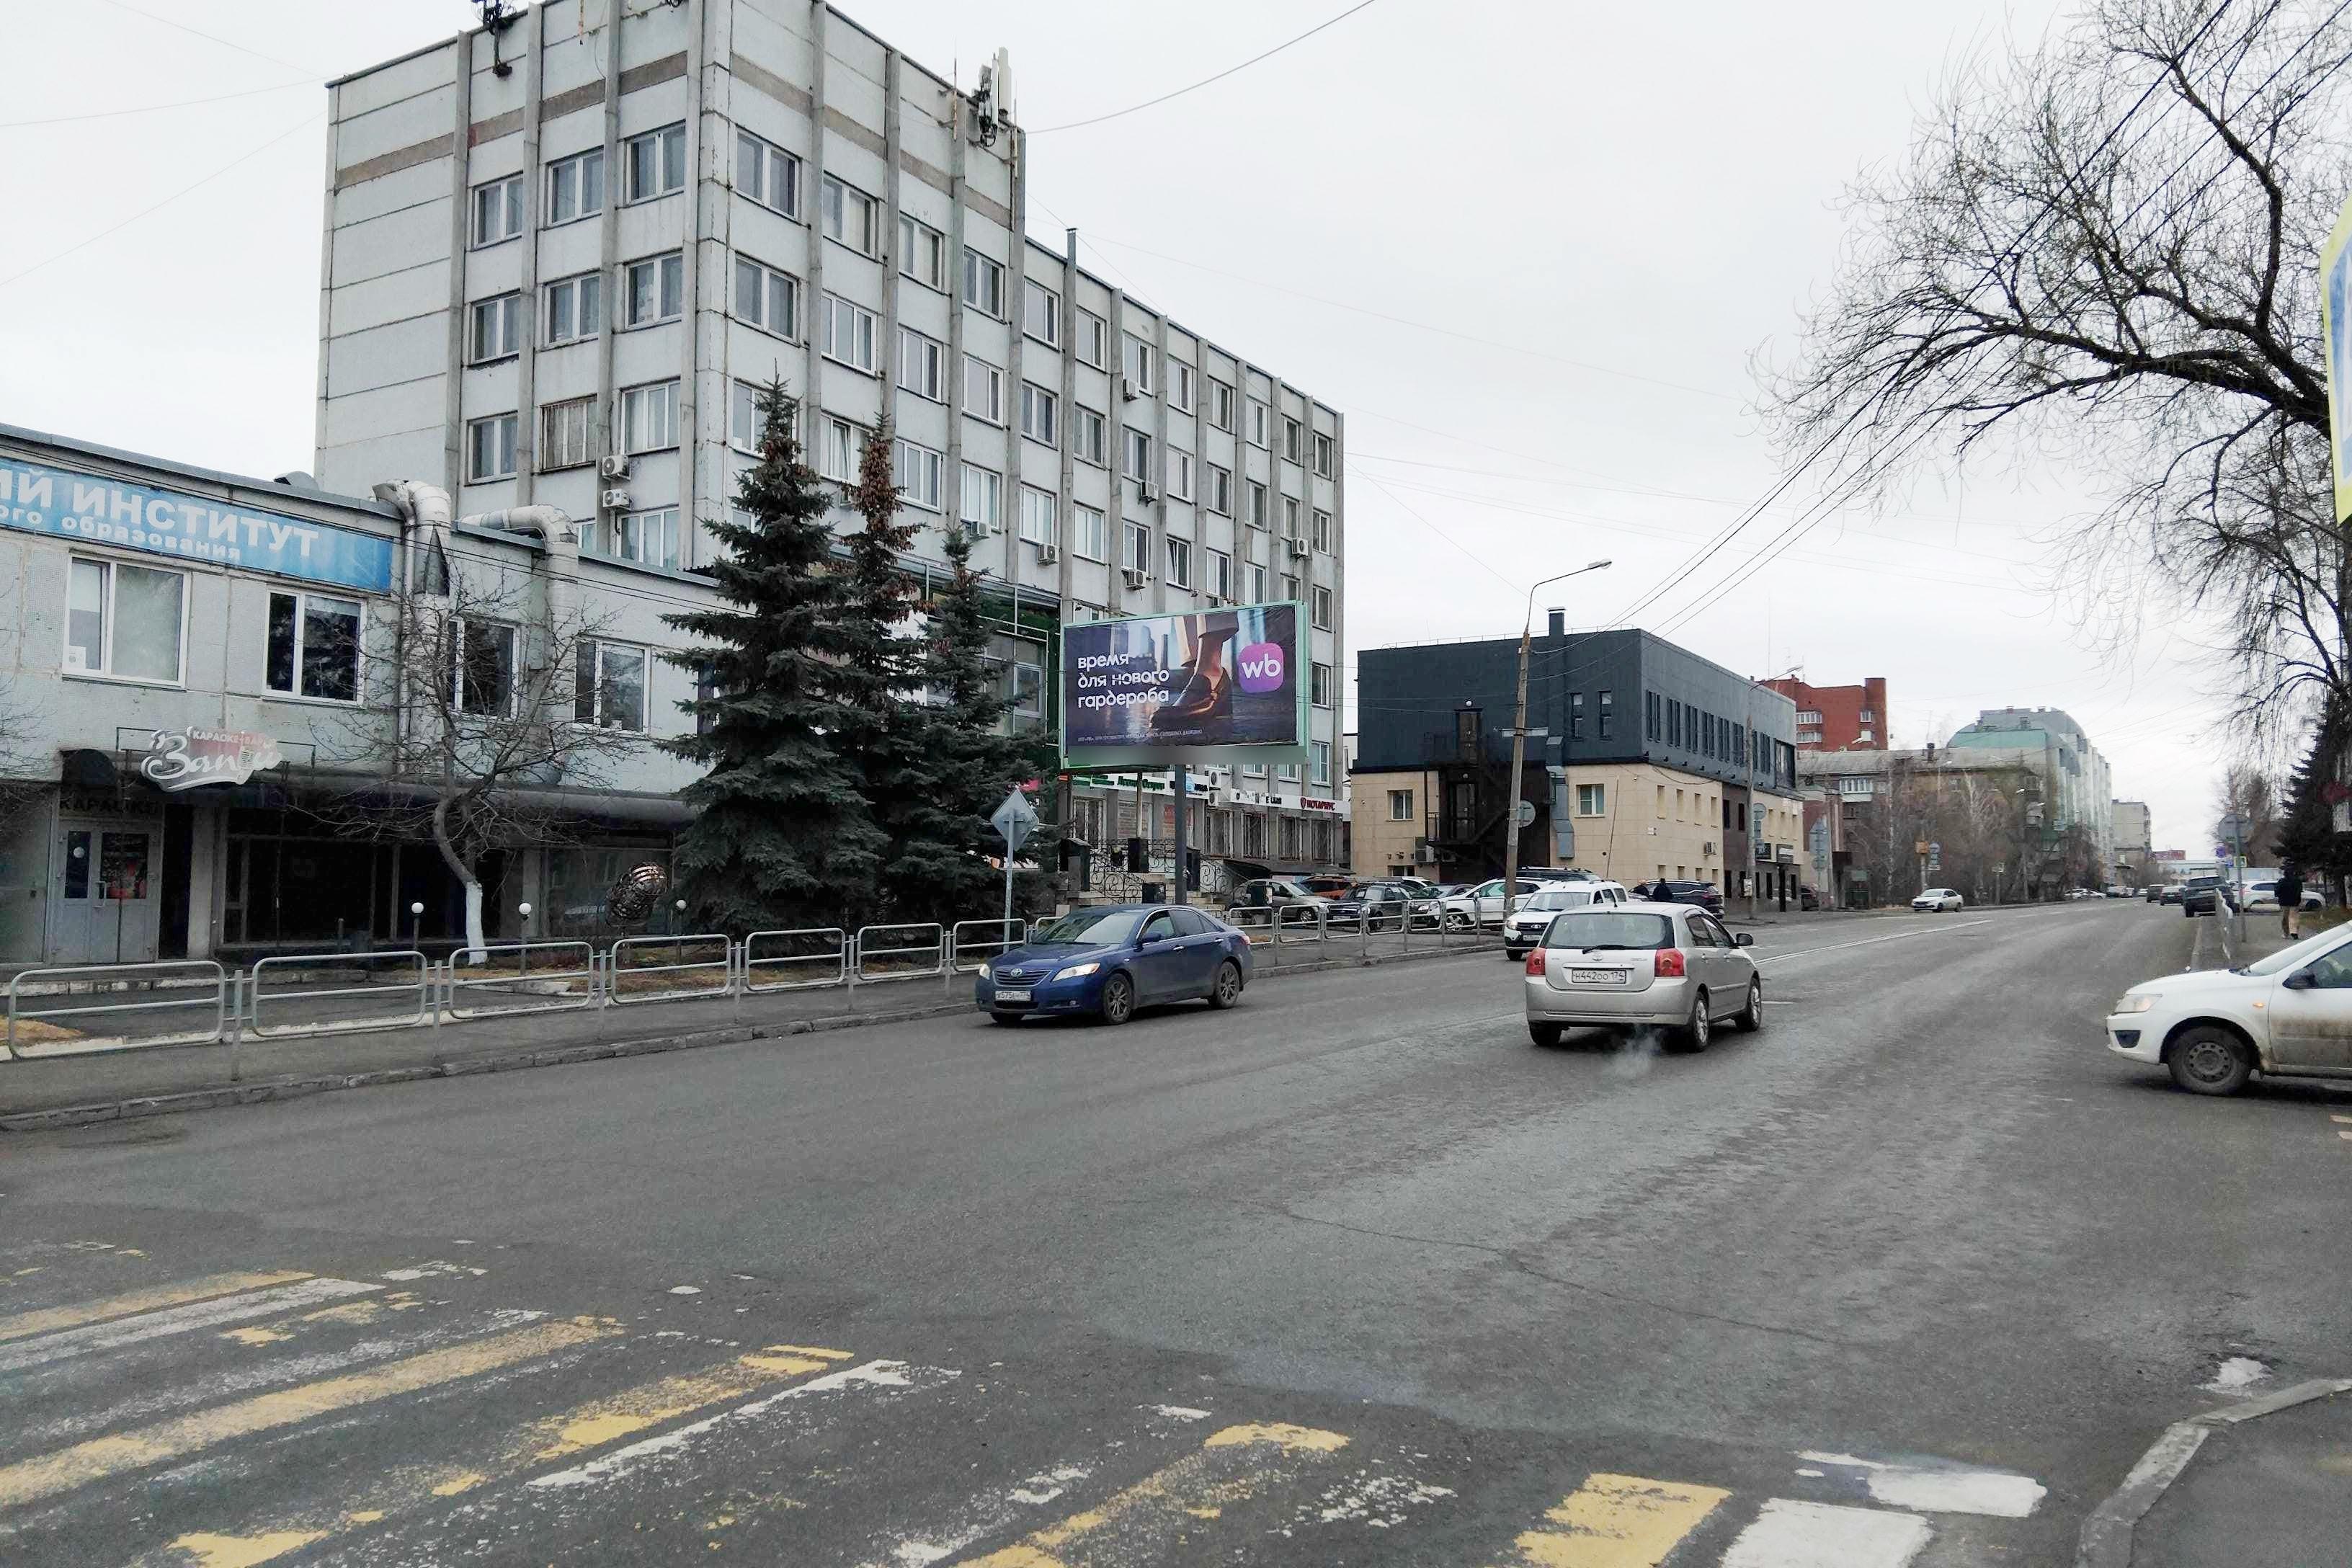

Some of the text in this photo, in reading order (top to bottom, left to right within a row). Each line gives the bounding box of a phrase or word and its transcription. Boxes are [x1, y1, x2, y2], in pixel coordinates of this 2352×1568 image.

[73, 482, 318, 557] ИНСТИТУТ
[62, 516, 241, 559] образования
[1078, 654, 1129, 672] время
[1242, 653, 1281, 680] wb
[1078, 669, 1170, 688] для нового
[1078, 688, 1170, 710] гардероба
